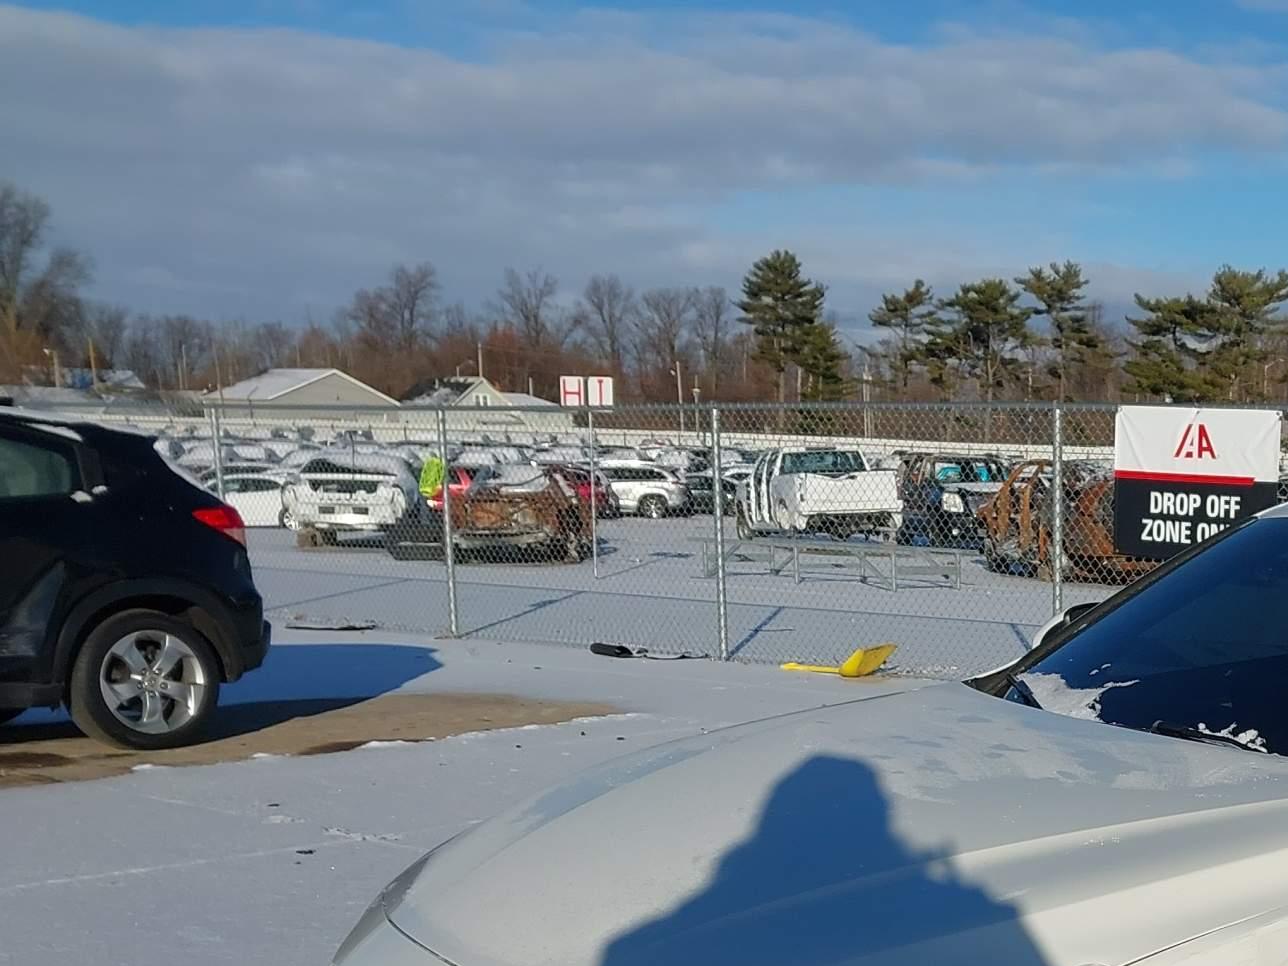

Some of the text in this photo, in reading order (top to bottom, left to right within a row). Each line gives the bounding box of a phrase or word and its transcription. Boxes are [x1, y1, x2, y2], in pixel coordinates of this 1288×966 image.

[1150, 491, 1240, 519] DROP OFF
[1141, 518, 1192, 544] ZONE
